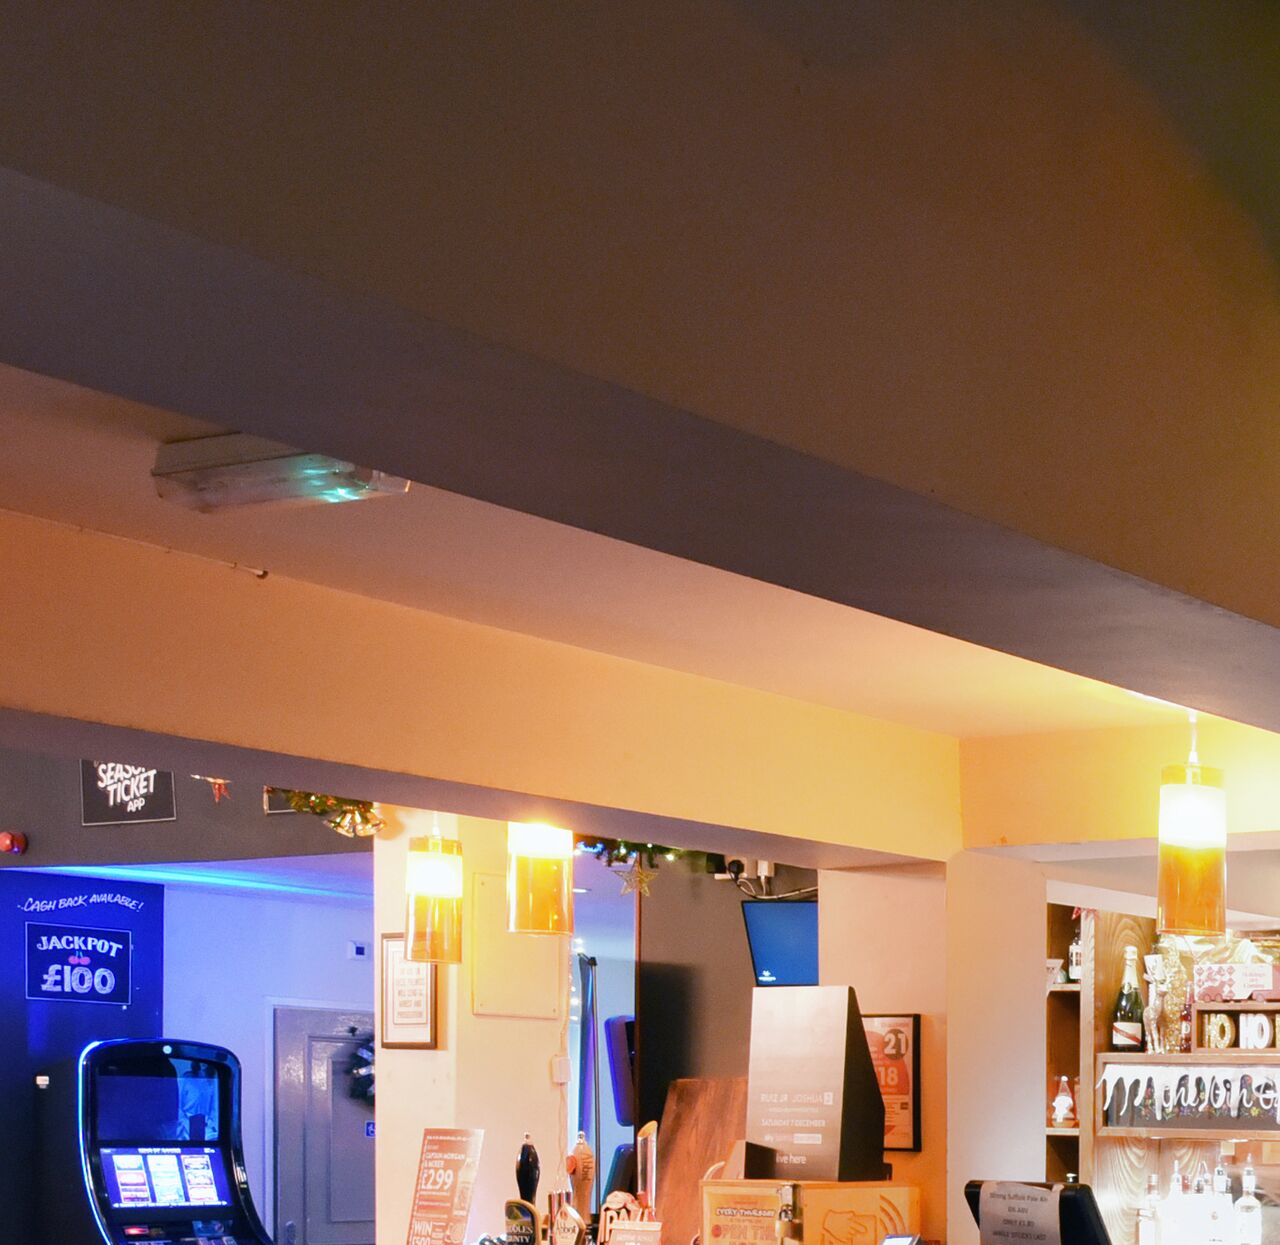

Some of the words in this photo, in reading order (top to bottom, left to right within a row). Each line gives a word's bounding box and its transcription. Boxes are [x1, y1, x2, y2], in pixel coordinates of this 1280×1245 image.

[107, 769, 157, 806] TICKET
[127, 798, 145, 812] APP
[24, 898, 55, 912] CASH
[58, 895, 89, 909] BACK
[89, 894, 143, 912] AVAILABLE!
[37, 935, 123, 957] JACKPOT
[41, 964, 116, 994] £100
[1203, 1013, 1236, 1048] HO
[1239, 1013, 1273, 1048] HO
[884, 1033, 906, 1055] 21
[878, 1066, 899, 1086] 18
[776, 1152, 788, 1163] live
[789, 1153, 806, 1164] here
[413, 1221, 433, 1236] WIN
[711, 1224, 748, 1240] OPEN
